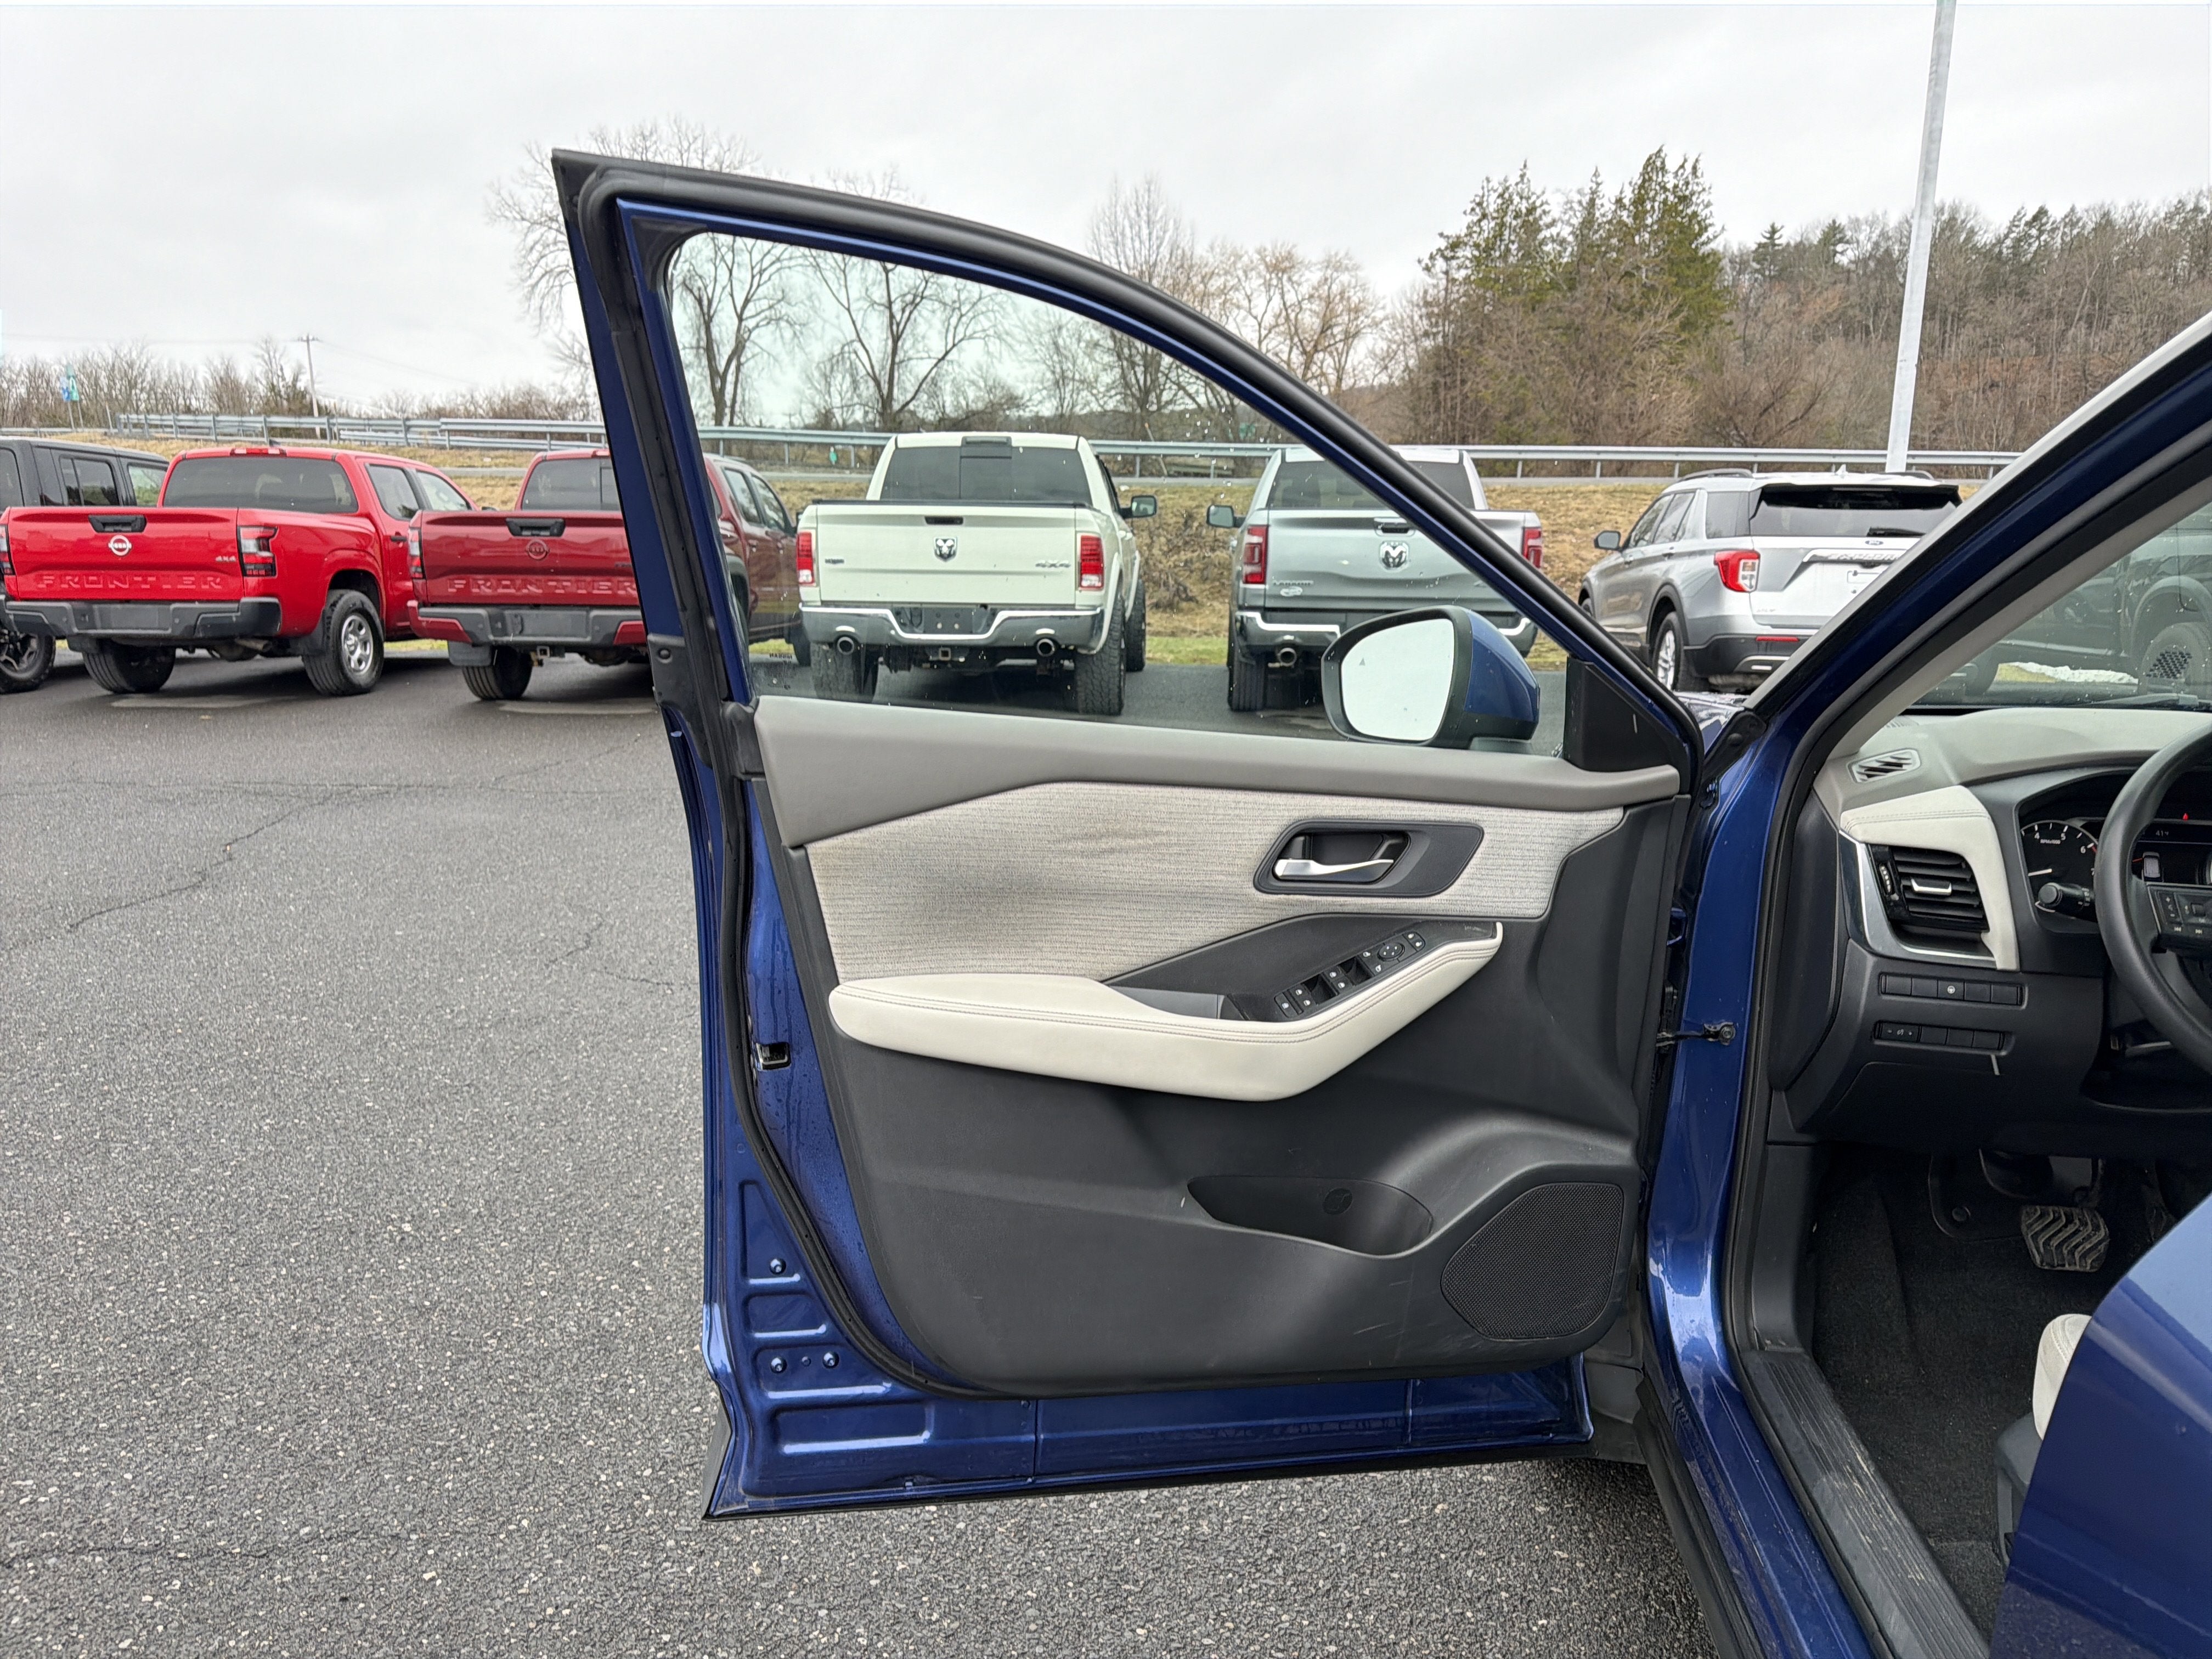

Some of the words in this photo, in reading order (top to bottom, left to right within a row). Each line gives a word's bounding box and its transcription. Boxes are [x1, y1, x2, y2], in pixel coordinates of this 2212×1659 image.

[37, 575, 222, 589] FRONTIER
[447, 579, 639, 596] FRONTIER
[2080, 845, 2086, 854] 6
